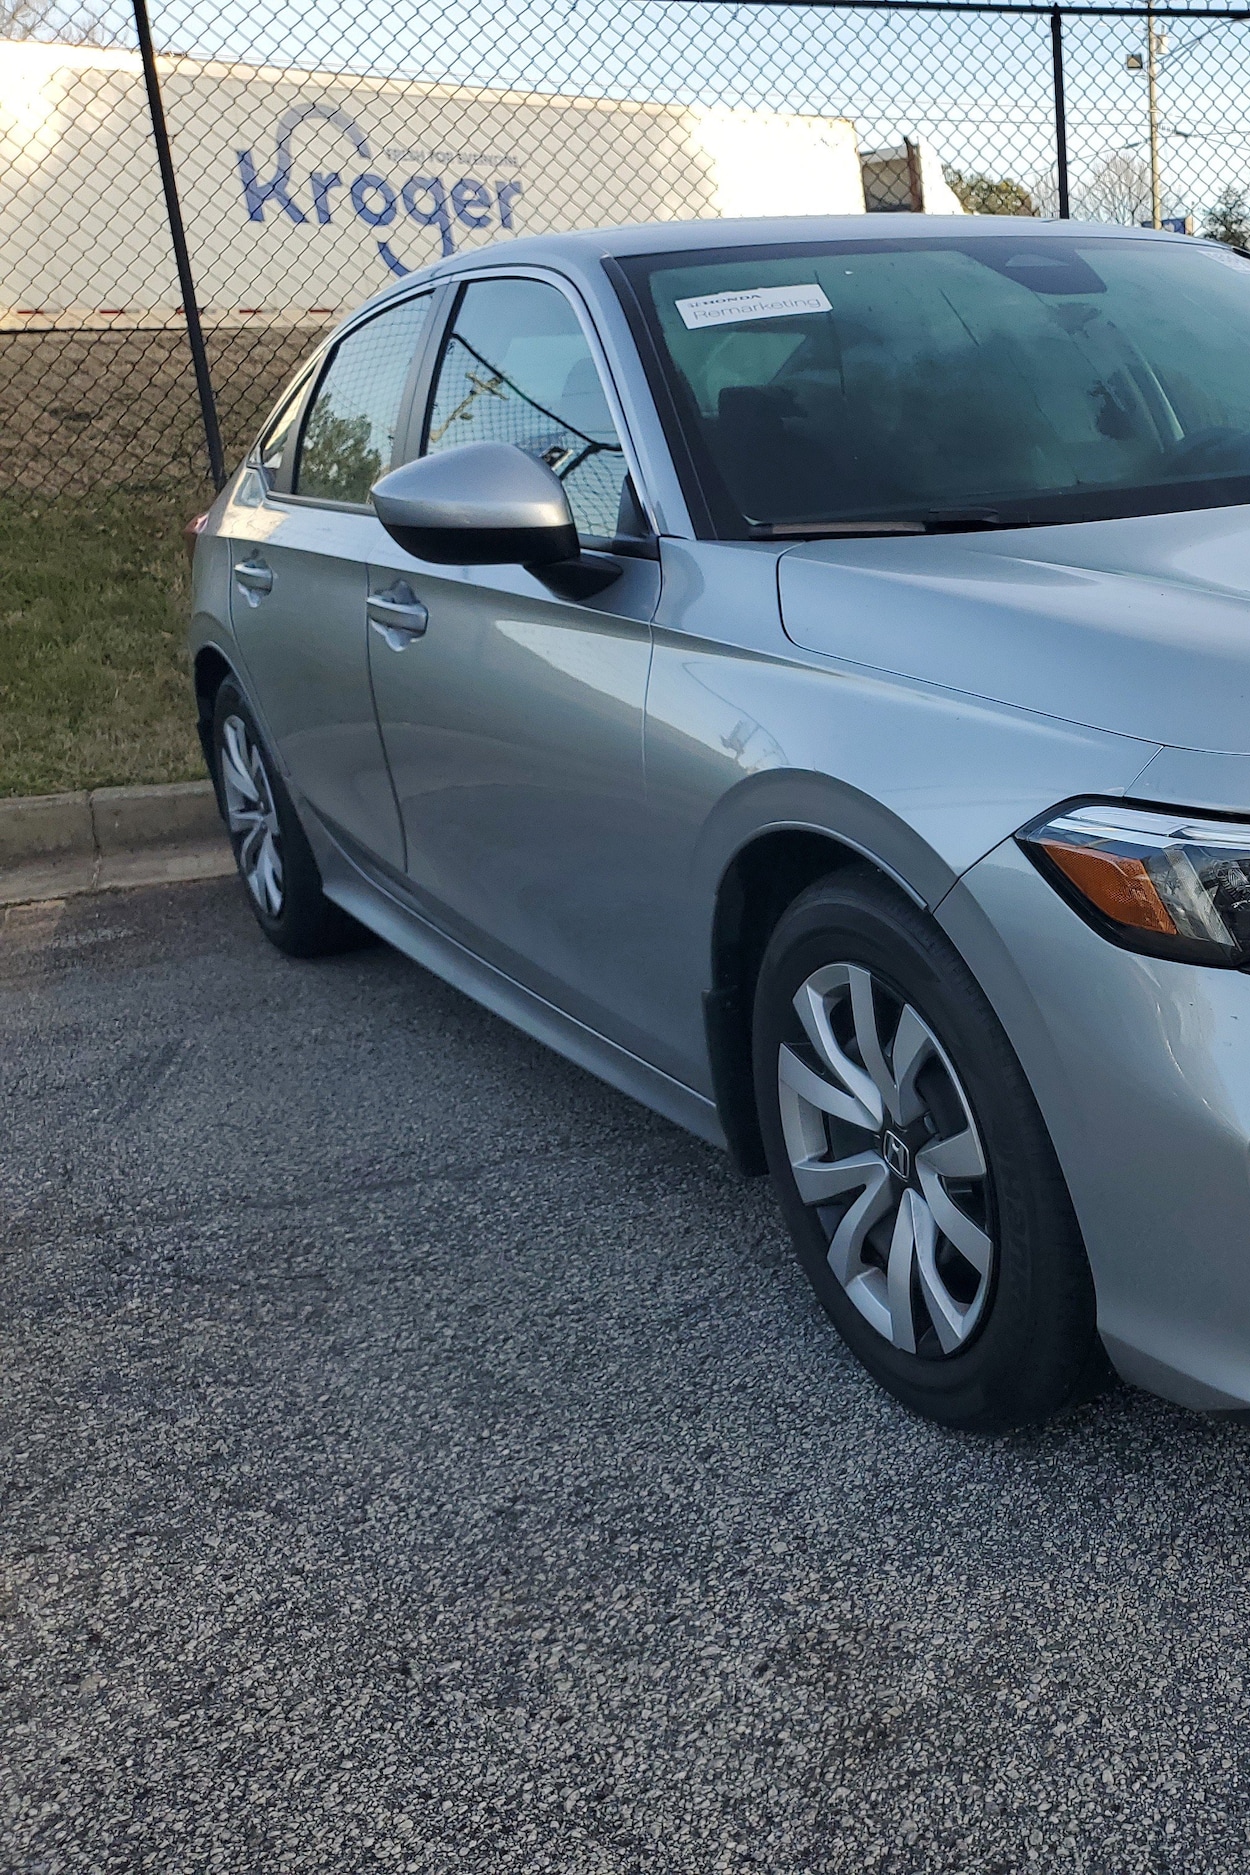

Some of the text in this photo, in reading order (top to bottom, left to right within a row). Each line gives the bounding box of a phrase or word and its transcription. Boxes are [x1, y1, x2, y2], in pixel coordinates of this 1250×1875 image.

[236, 103, 523, 277] Kroger
[693, 297, 822, 321] Remarketing
[703, 293, 762, 305] HONDA
